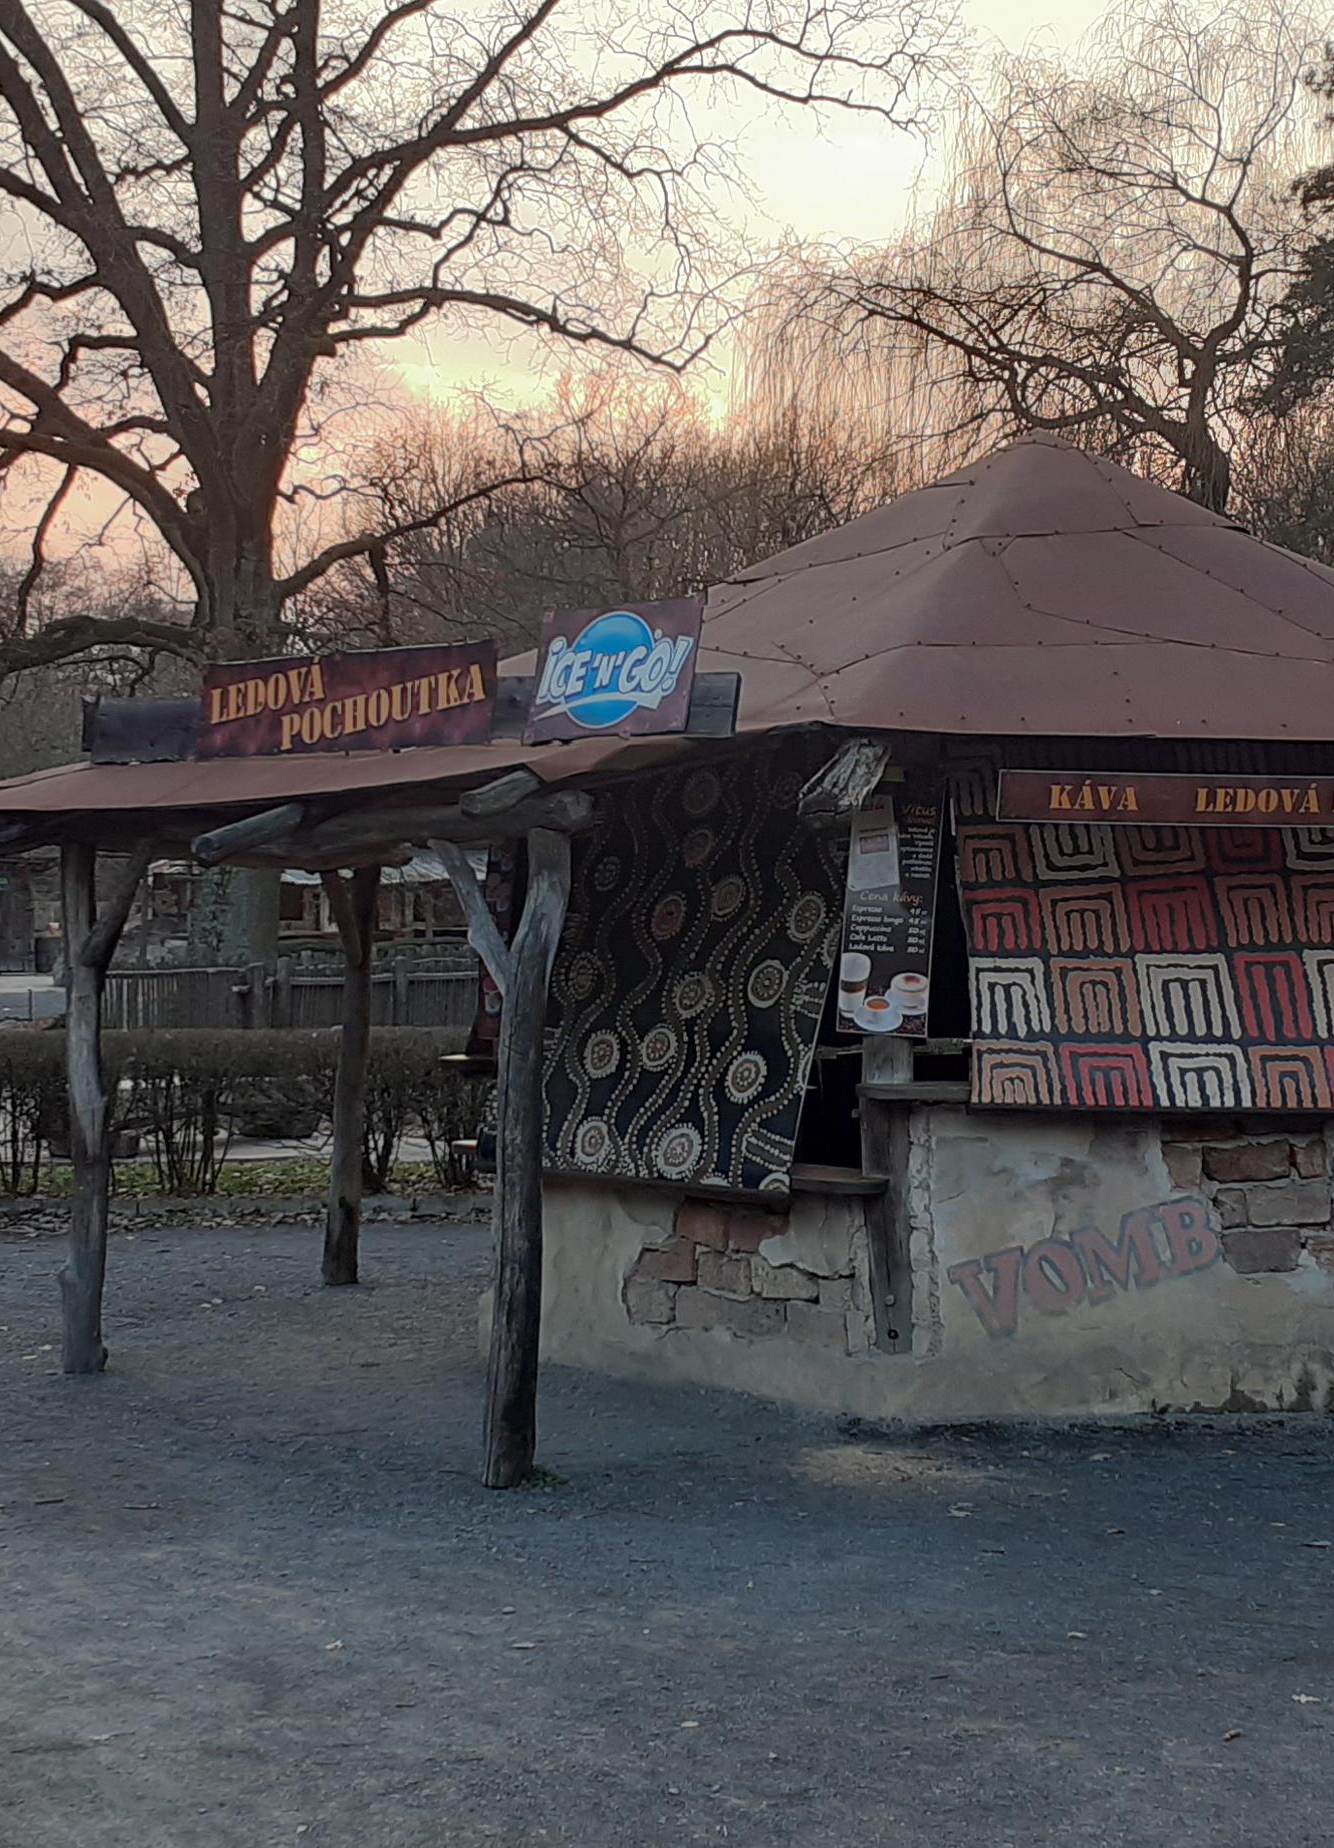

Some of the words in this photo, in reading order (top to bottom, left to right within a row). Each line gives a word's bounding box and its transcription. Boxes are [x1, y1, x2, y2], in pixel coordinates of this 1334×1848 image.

[210, 655, 325, 725] LEDOVÁ
[279, 663, 487, 751] POCHOUTKA
[1048, 779, 1139, 811] KÁVA
[1194, 782, 1321, 814] LEDOVÁ
[859, 890, 888, 902] Cena
[948, 1195, 1221, 1340] VOMB
